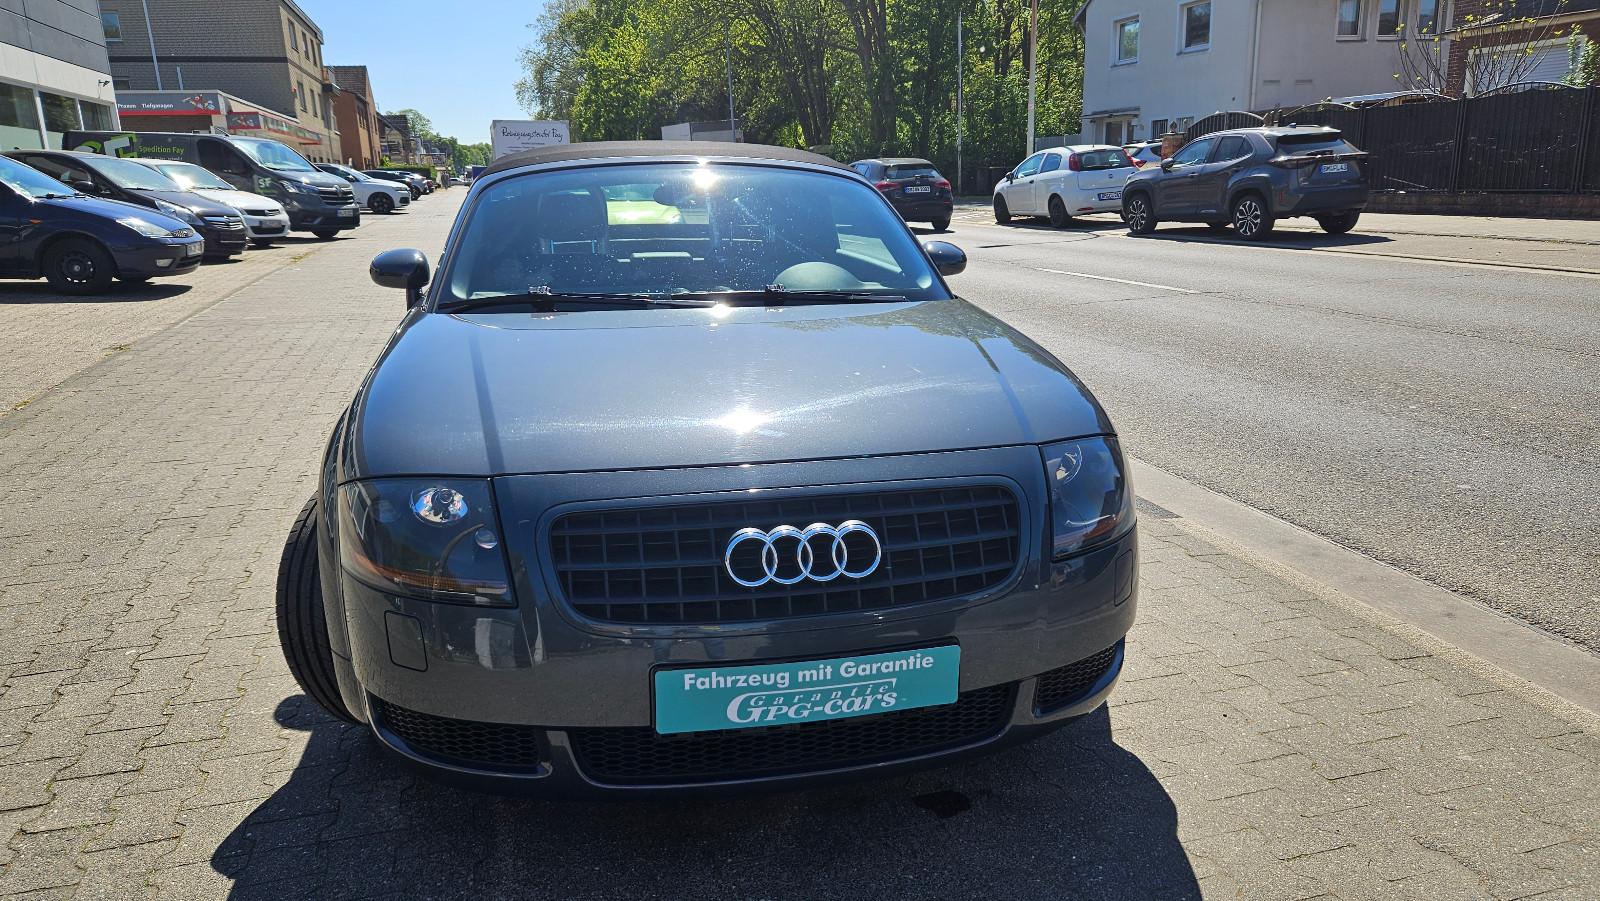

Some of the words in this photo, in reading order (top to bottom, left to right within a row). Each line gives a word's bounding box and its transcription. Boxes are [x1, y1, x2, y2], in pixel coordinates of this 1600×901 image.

[139, 145, 171, 154] Spedition
[172, 146, 185, 155] Fay
[683, 669, 790, 691] Fahrzeug
[798, 665, 832, 683] mit
[839, 653, 934, 678] Garantie
[726, 688, 898, 724] GPG-cars
[750, 684, 889, 707] Garantie
